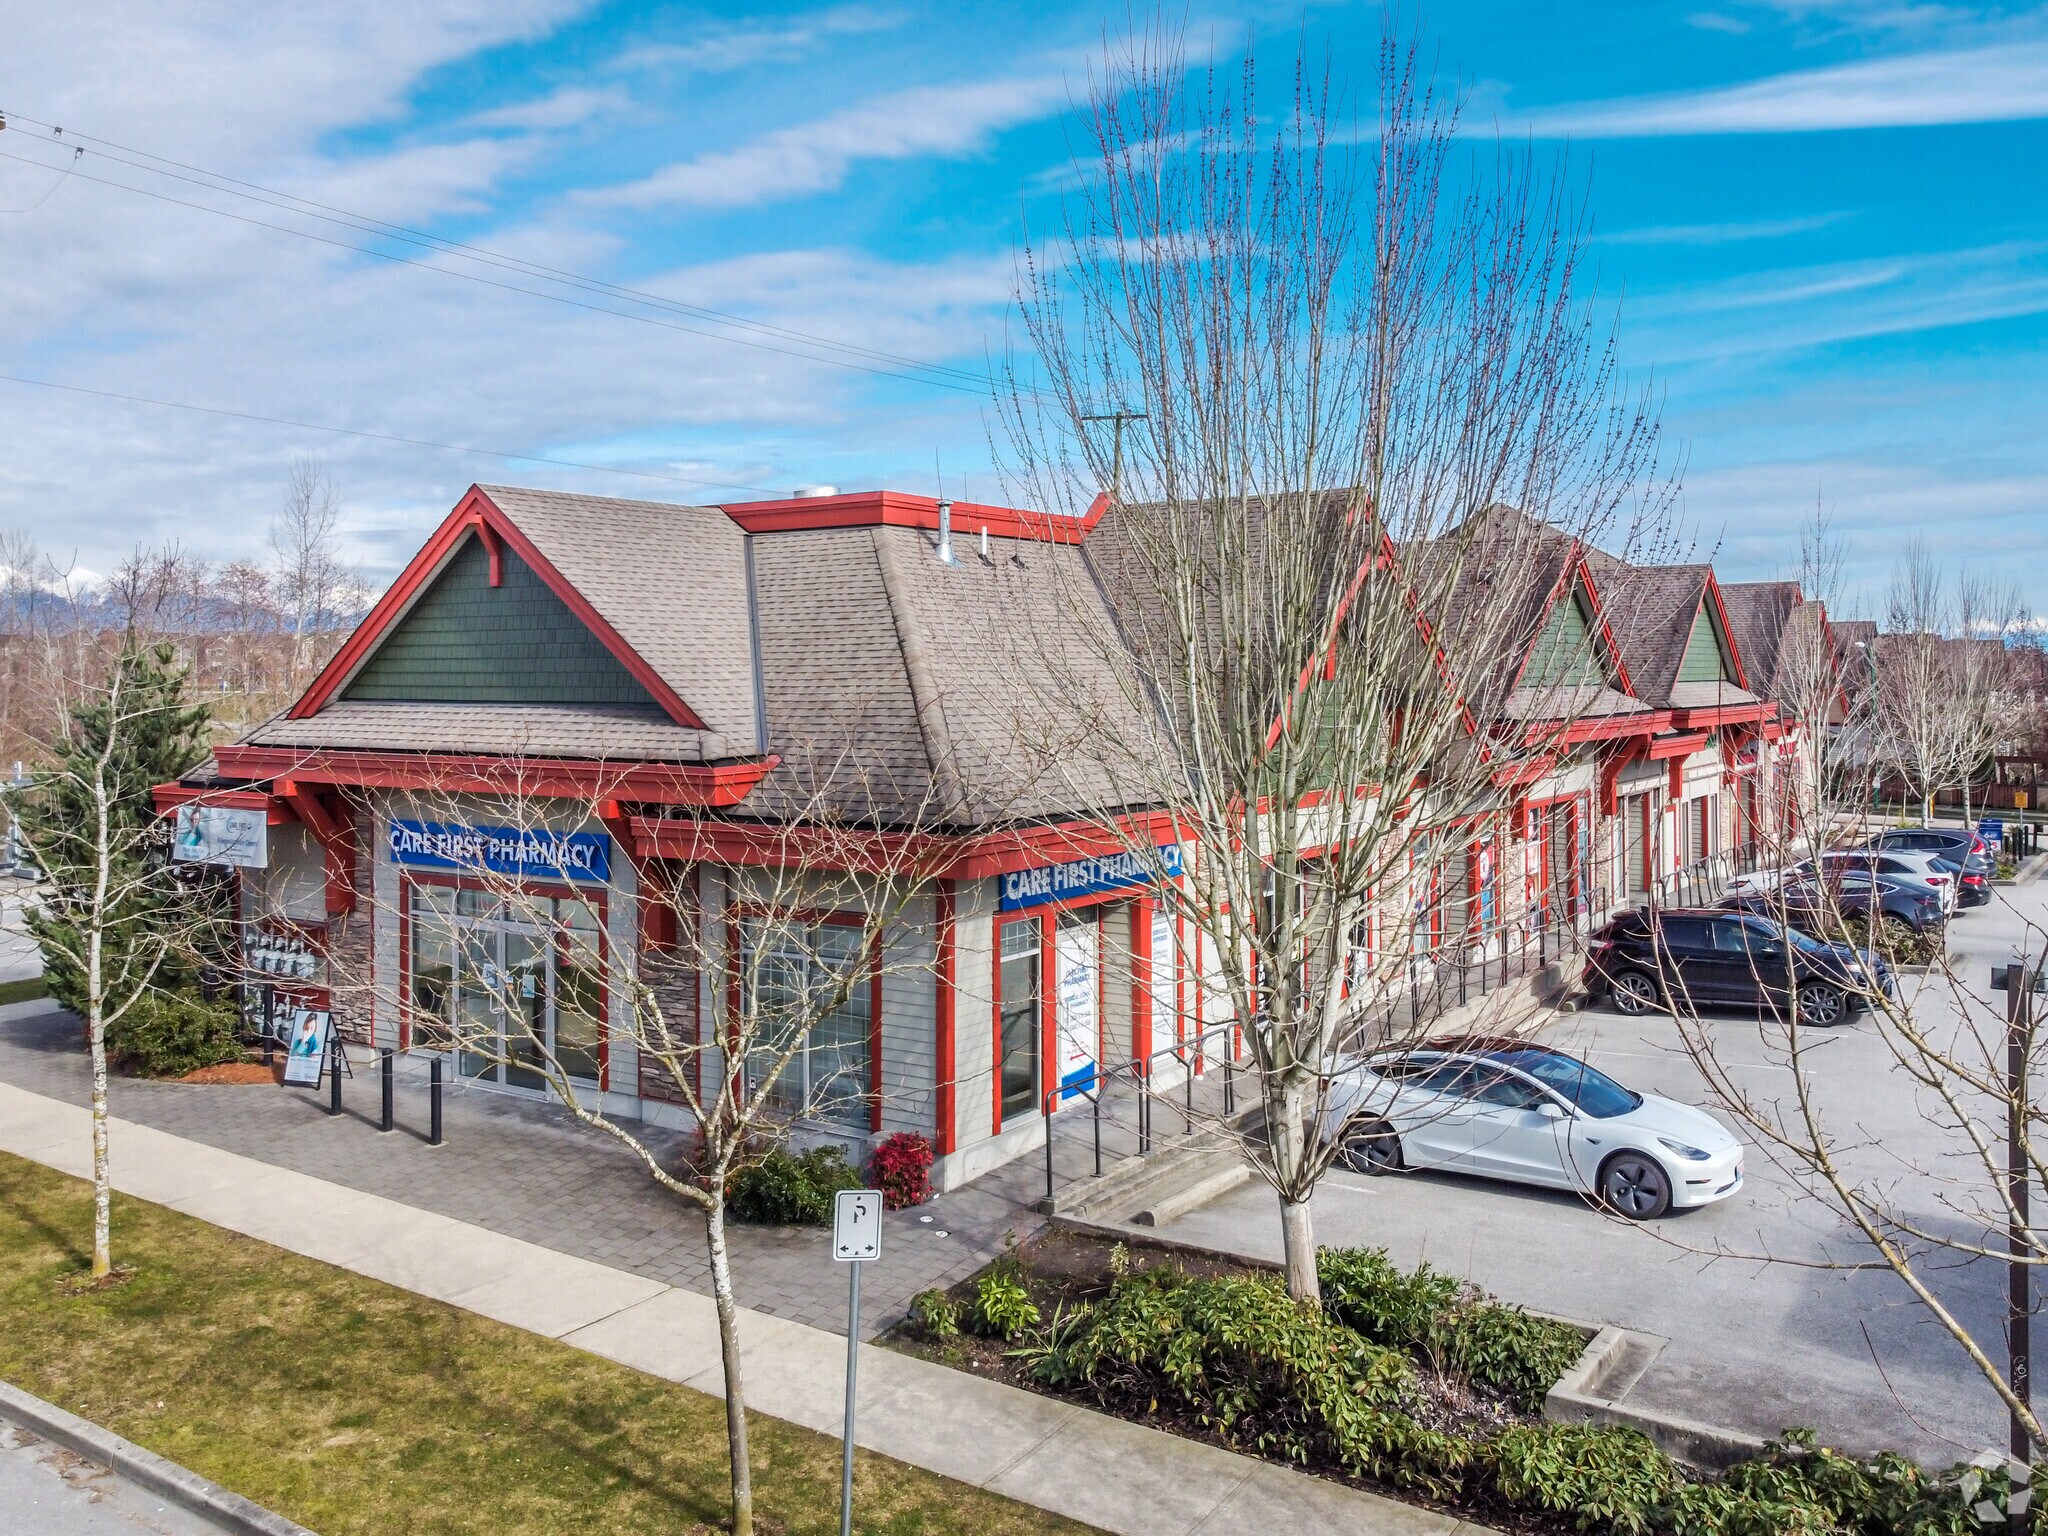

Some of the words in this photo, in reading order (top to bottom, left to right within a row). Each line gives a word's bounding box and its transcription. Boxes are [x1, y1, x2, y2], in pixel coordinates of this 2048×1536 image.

[390, 830, 431, 854] CARE
[438, 834, 483, 858] FIRST
[490, 838, 595, 868] PHARMACY
[1006, 868, 1051, 900] CARE
[1054, 860, 1095, 890] FIRST
[1100, 845, 1180, 881] PHARCY
